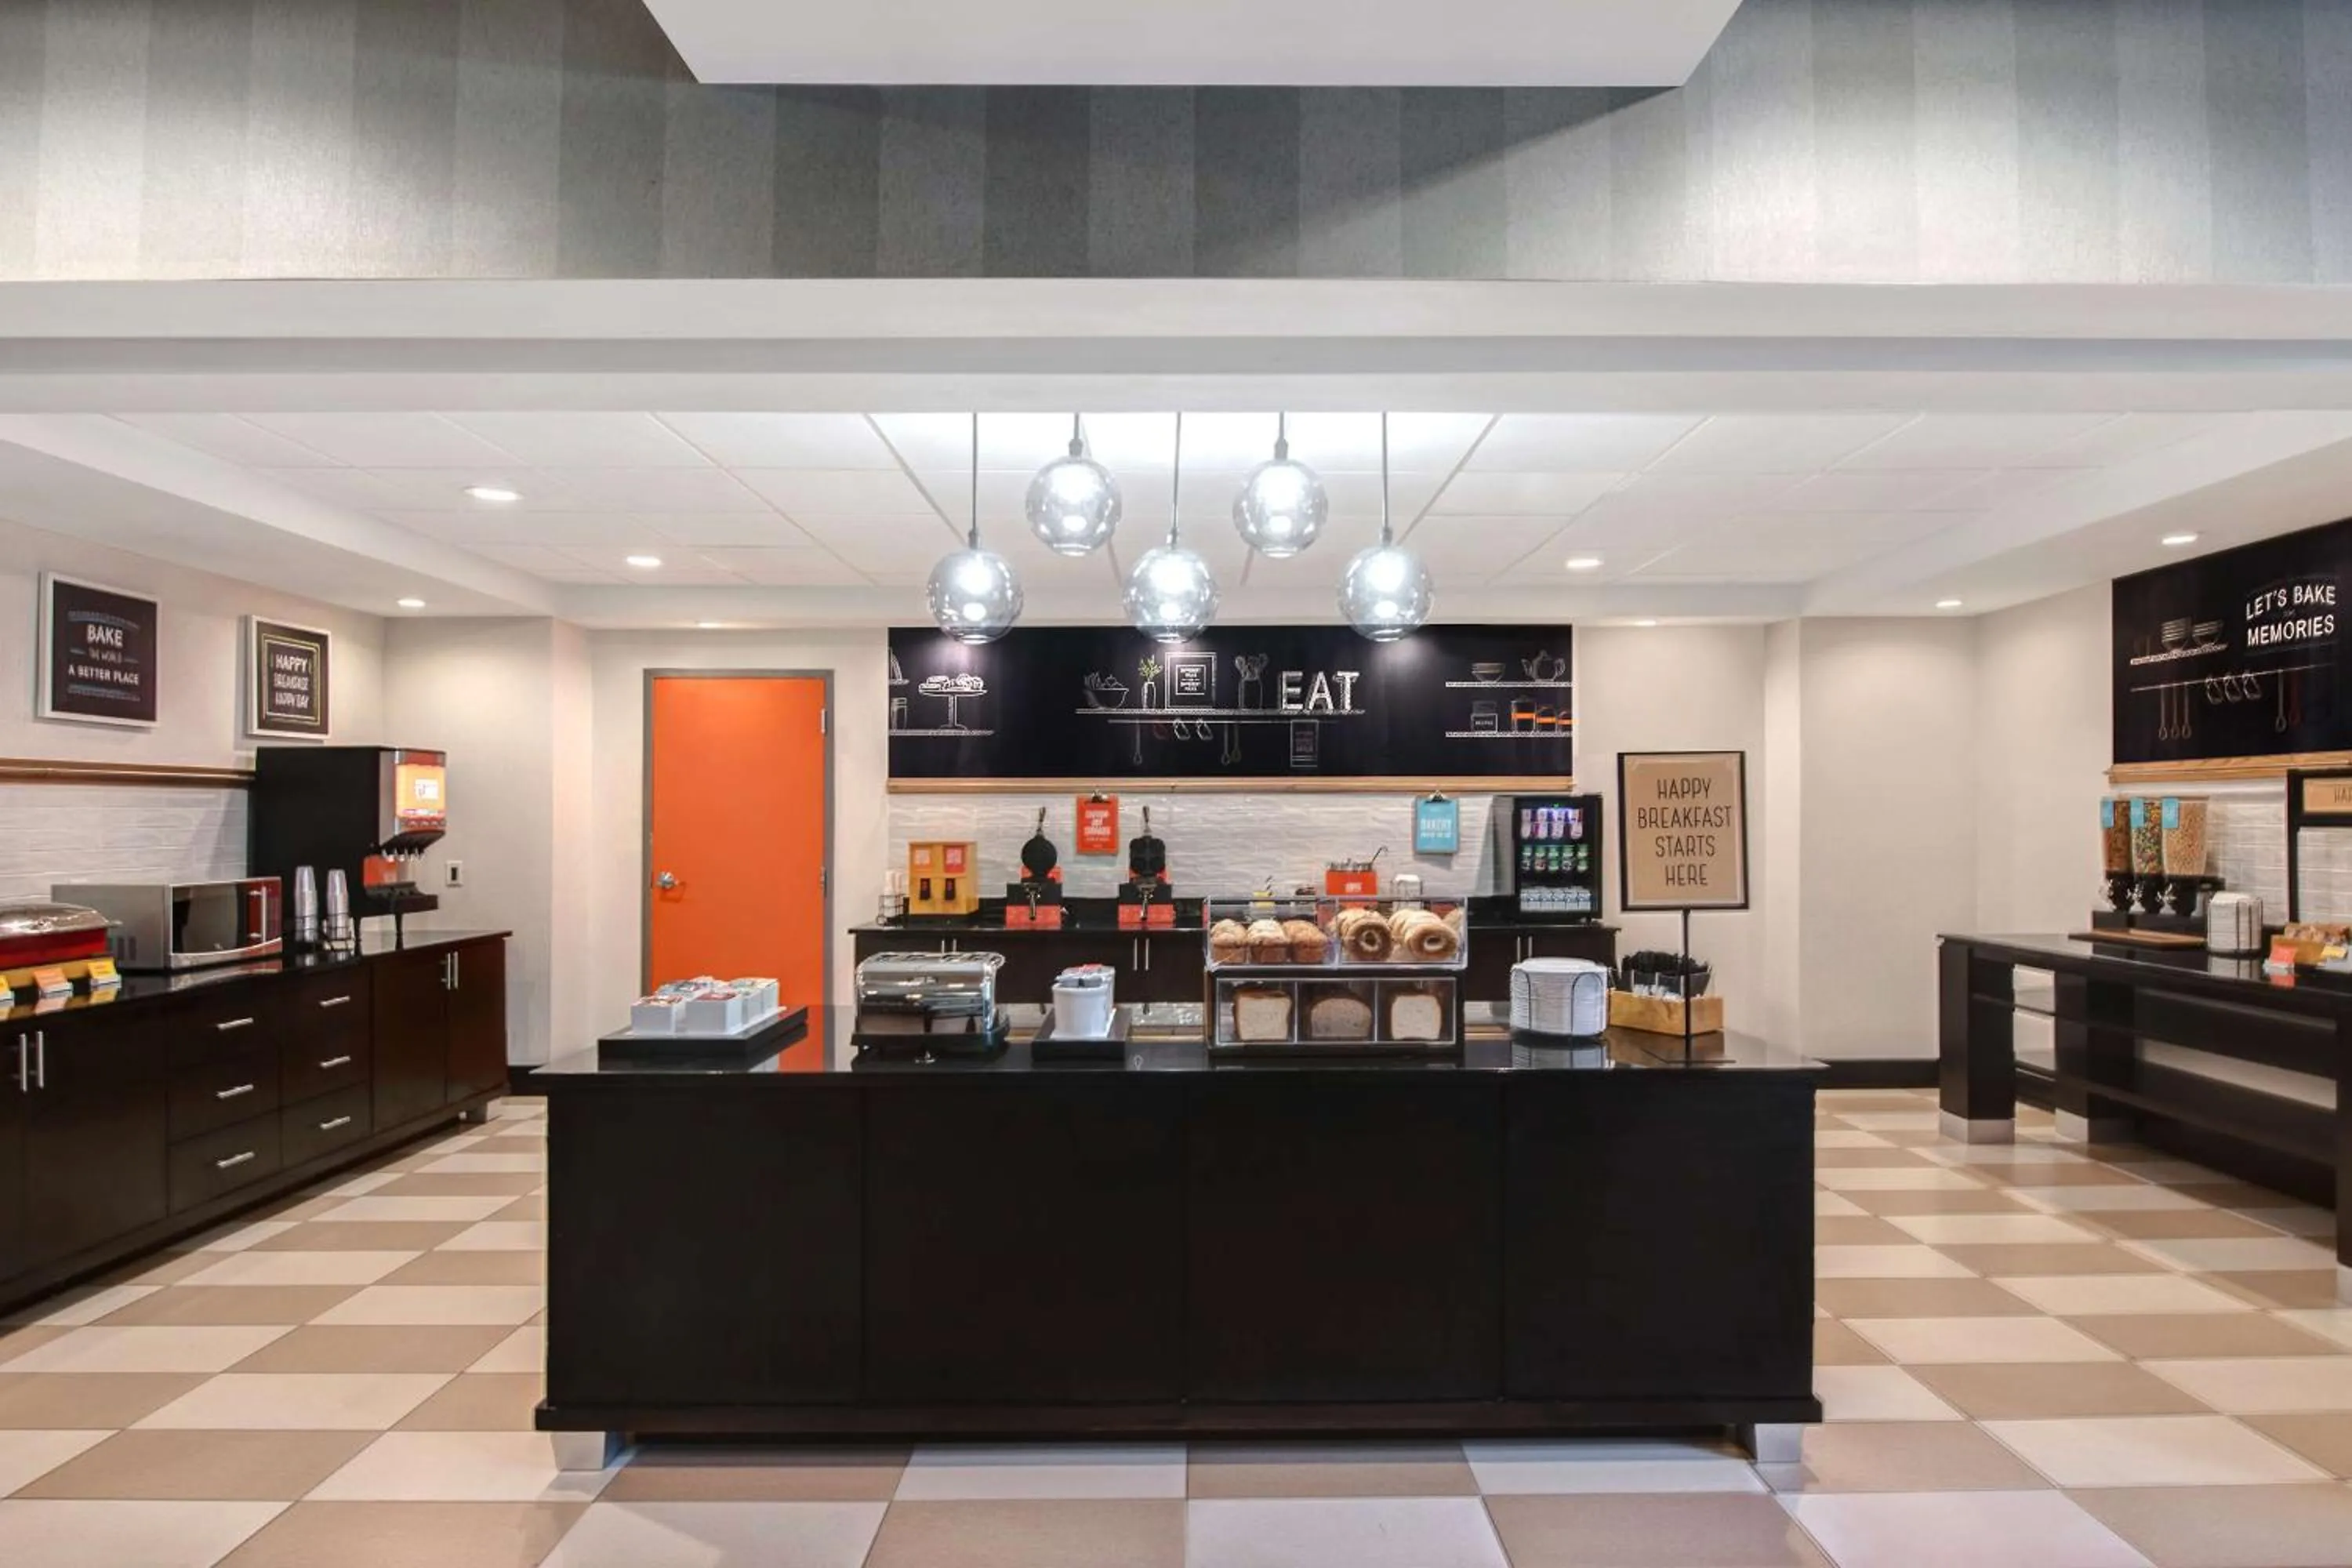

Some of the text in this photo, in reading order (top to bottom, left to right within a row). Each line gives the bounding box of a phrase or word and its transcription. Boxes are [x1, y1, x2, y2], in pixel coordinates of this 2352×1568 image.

[2246, 584, 2336, 621] LET'S BAKE
[87, 624, 123, 648] BAKE
[2247, 614, 2335, 647] MEMORIES
[68, 664, 140, 686] A BETTER PLACE
[275, 654, 308, 673] HAPPY
[1279, 670, 1360, 711] EAT
[1657, 777, 1712, 800] HAPPY
[1637, 805, 1733, 829] BREAKFAST
[1655, 834, 1716, 857] STARTS
[1664, 863, 1709, 887] HERE
